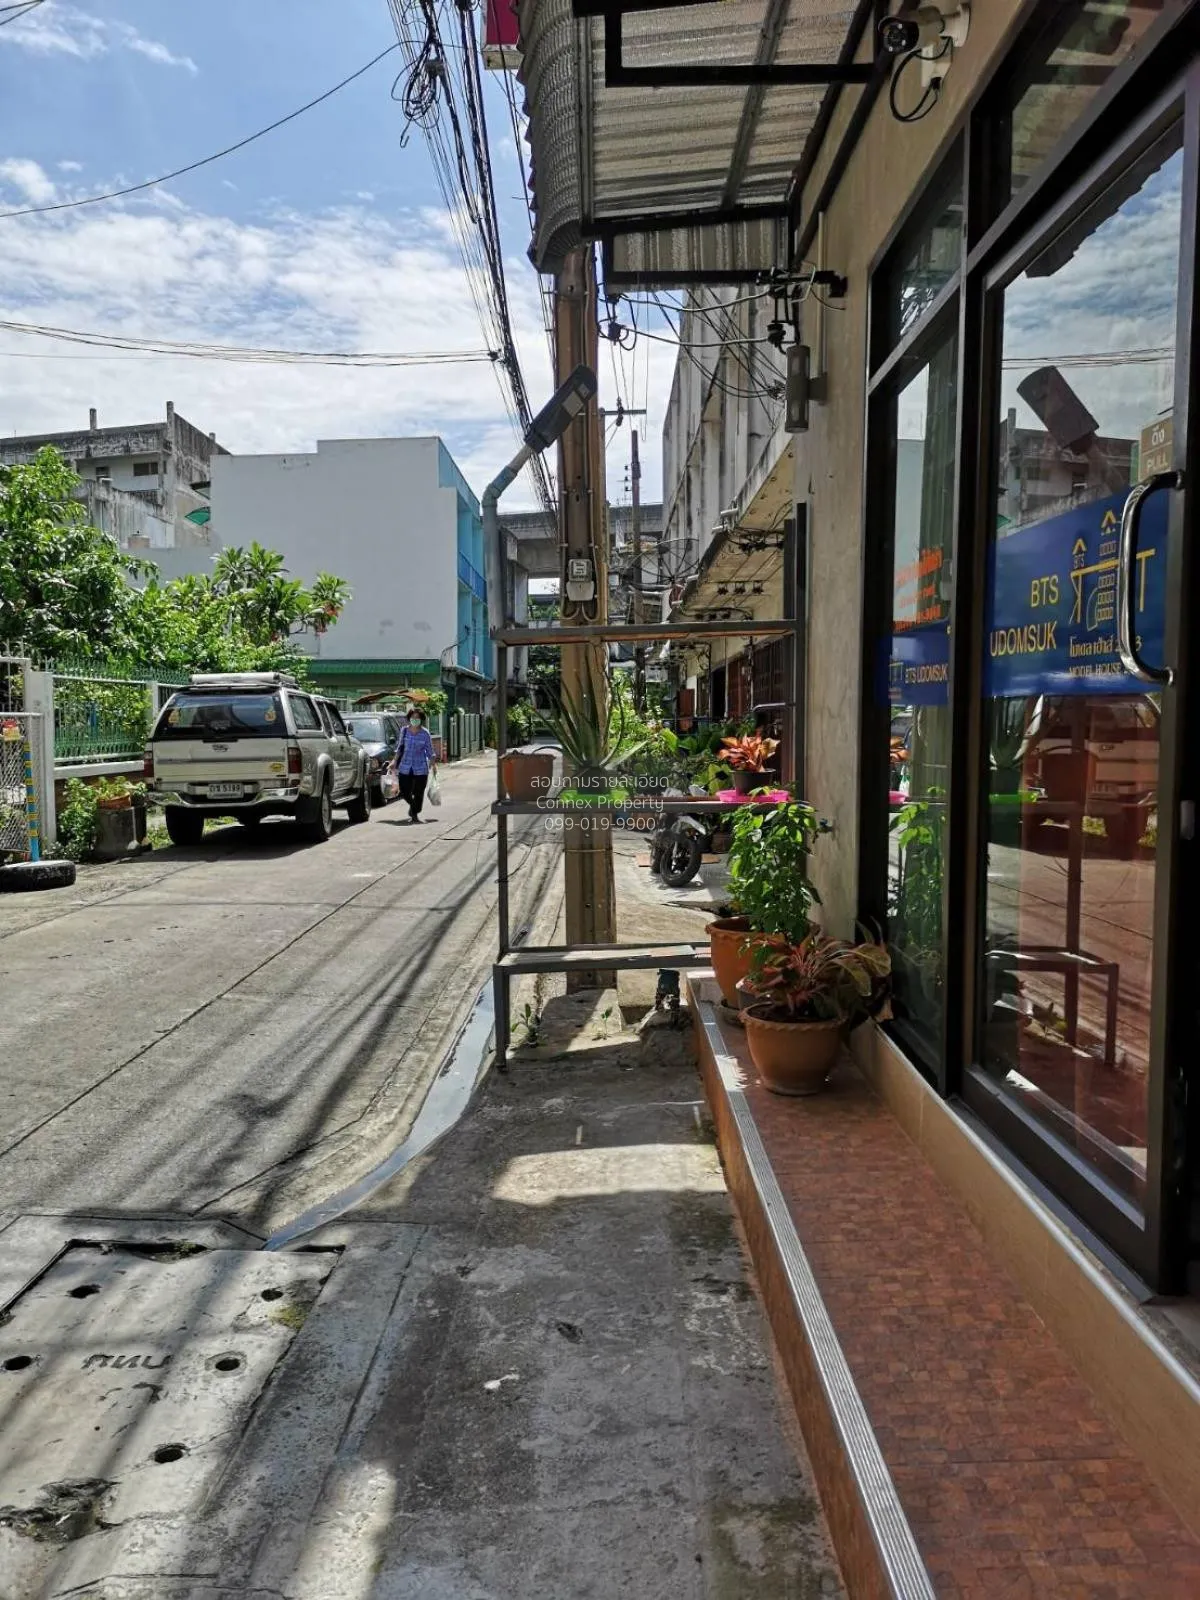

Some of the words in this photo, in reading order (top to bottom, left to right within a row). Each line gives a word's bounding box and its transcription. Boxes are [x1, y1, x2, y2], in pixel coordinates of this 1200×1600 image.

[1146, 452, 1169, 473] PULL
[1031, 575, 1059, 607] BTS
[990, 621, 1057, 657] UDOMSUK
